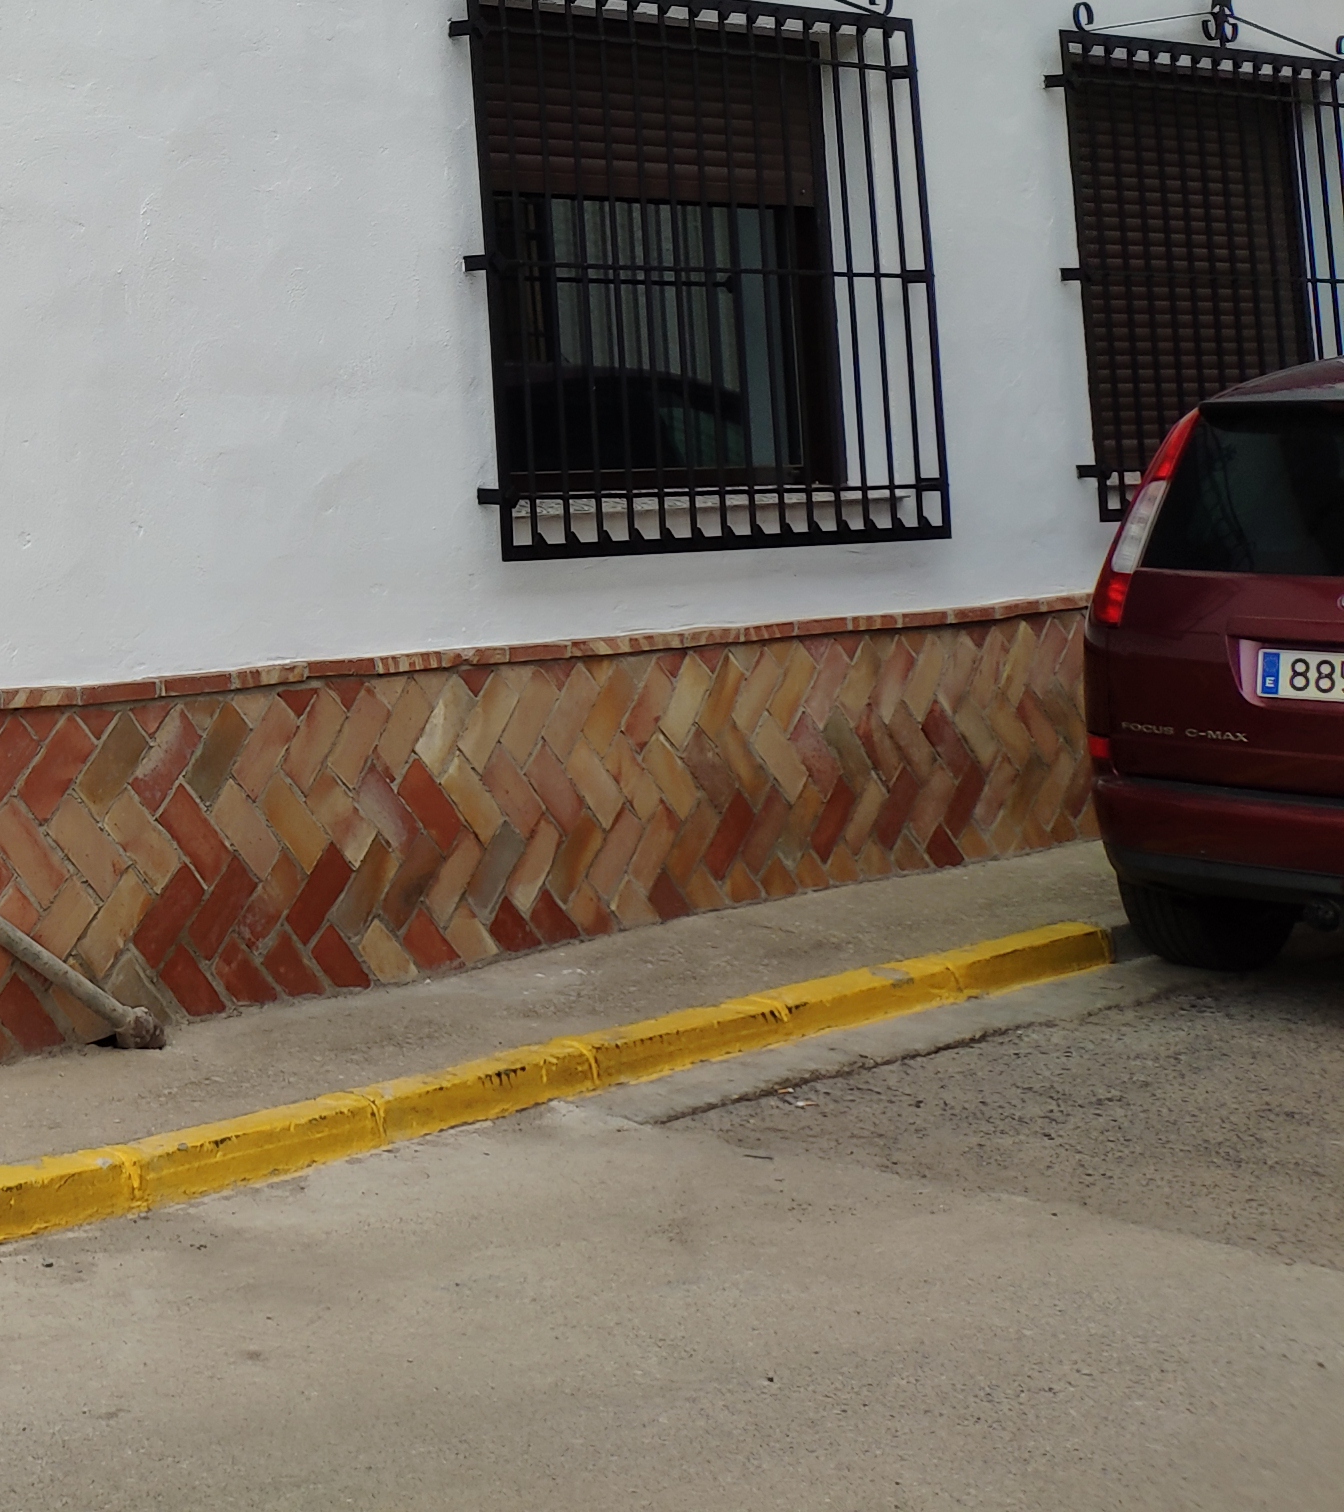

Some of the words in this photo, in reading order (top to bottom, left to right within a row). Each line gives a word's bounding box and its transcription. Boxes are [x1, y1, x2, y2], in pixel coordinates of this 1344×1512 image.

[1265, 676, 1275, 688] E
[1289, 657, 1344, 694] 88
[1121, 721, 1174, 735] FOCUS
[1185, 728, 1249, 742] C-MAX
